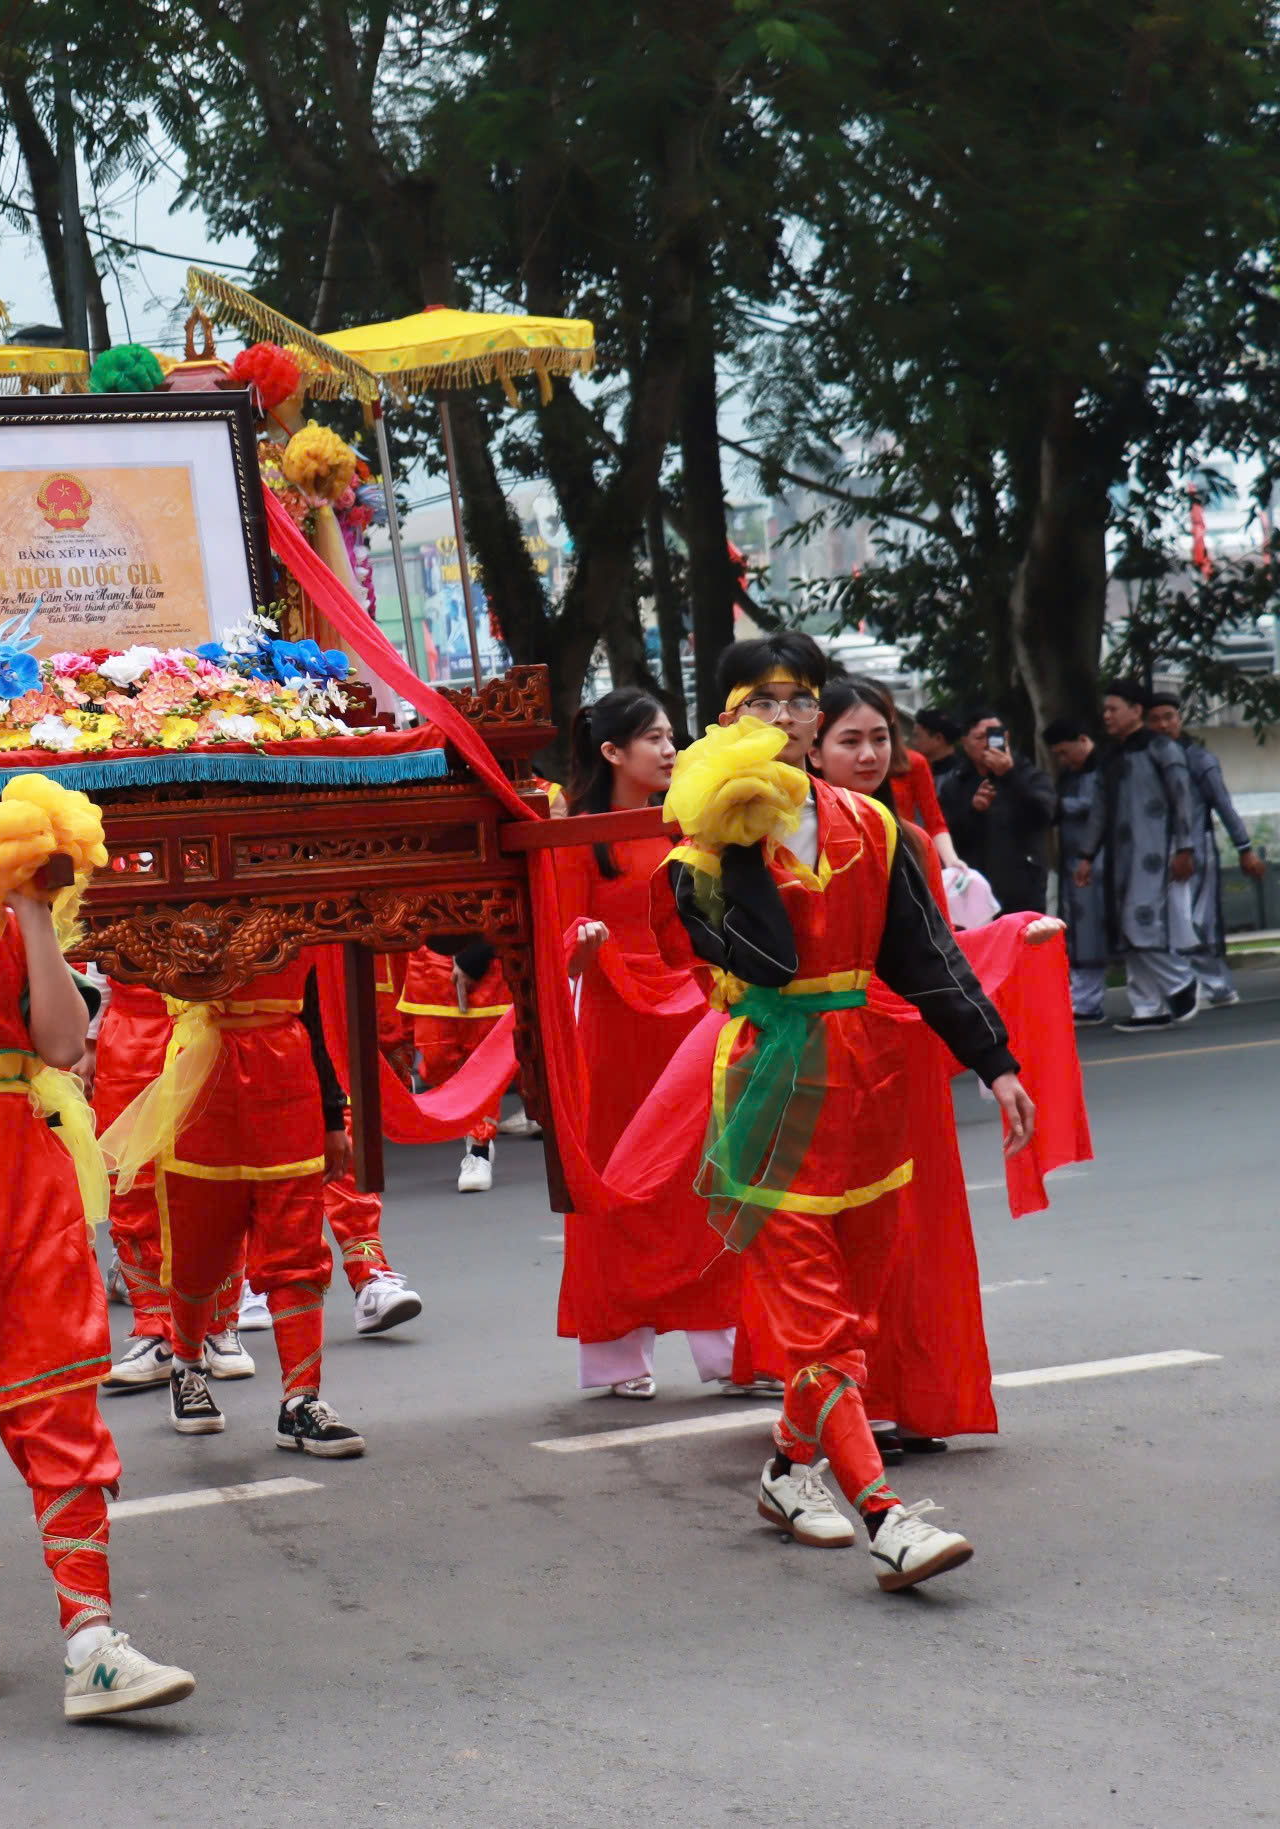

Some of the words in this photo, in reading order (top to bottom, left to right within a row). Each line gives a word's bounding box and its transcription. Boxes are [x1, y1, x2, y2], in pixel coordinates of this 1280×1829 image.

[18, 545, 55, 560] BẰNG
[59, 545, 85, 559] XẾP
[89, 547, 127, 560] HẠNG
[12, 564, 63, 589] TÍCH
[67, 561, 122, 588] QUỐC
[127, 562, 163, 585] GIA
[64, 589, 82, 602] Sơn
[84, 591, 94, 601] và
[95, 588, 126, 602] Hang
[37, 604, 62, 616] guyễn
[92, 1662, 119, 1689] N
